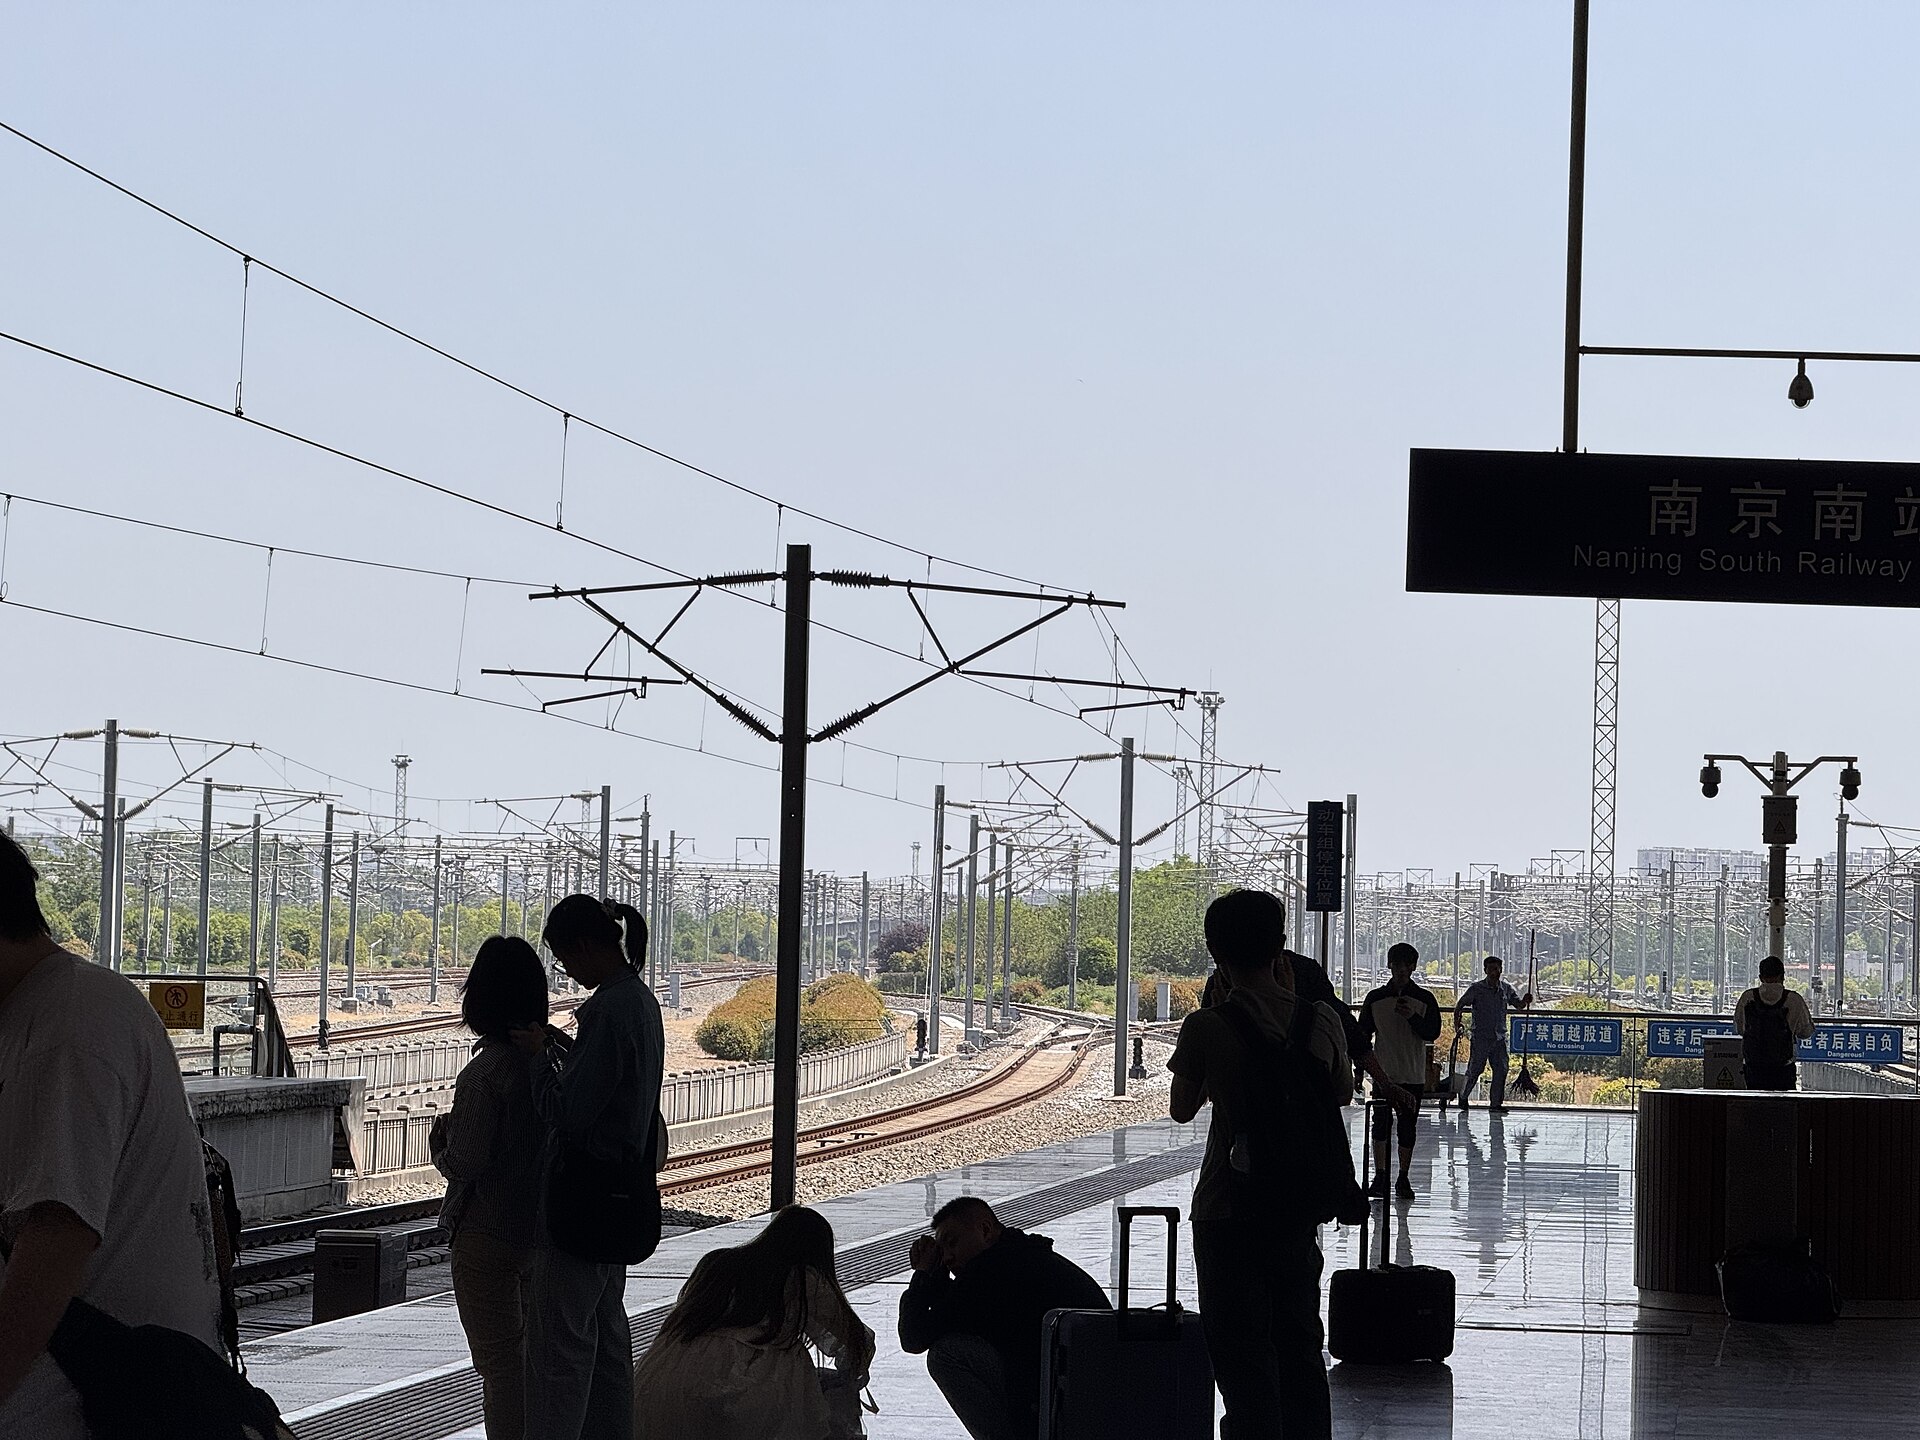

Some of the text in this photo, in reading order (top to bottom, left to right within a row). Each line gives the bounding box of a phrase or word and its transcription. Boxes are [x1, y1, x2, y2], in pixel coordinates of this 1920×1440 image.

[1573, 544, 1912, 582] Nanjing South Railway
[1315, 809, 1336, 905] 动车组停车位置
[1520, 1023, 1612, 1043] 严禁翻越股道
[1799, 1031, 1893, 1052] 违者后果自负
[1557, 1043, 1585, 1051] crossing
[1827, 1050, 1865, 1058] Dangerous!
